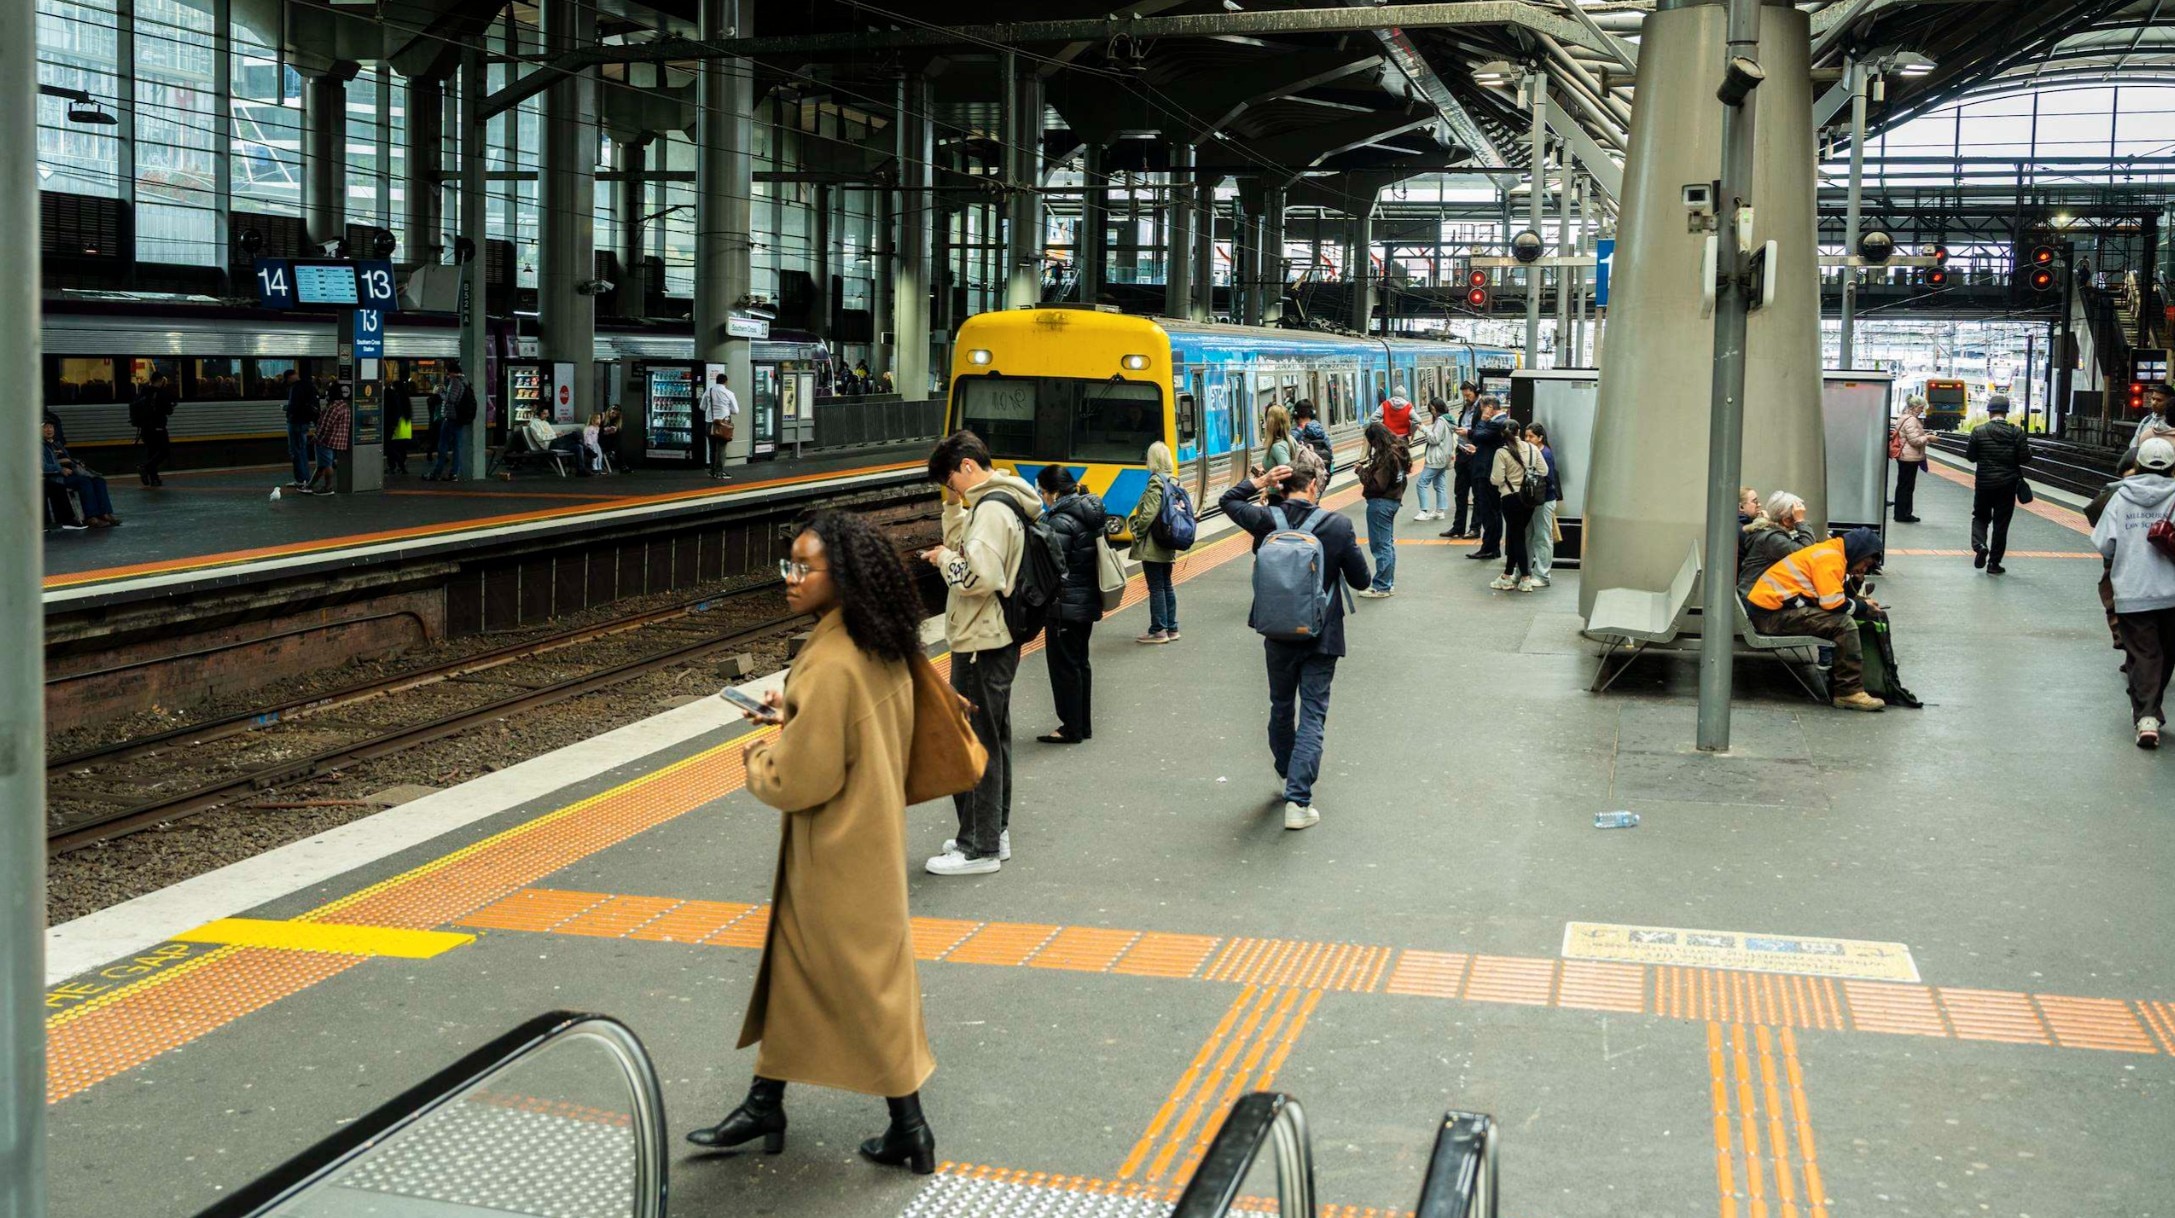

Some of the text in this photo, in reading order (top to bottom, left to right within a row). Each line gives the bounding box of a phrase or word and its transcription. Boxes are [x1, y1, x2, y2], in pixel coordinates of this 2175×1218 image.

[257, 267, 288, 297] 14
[361, 269, 392, 299] 13
[359, 309, 378, 332] 13
[45, 944, 191, 1007] HE GAP
